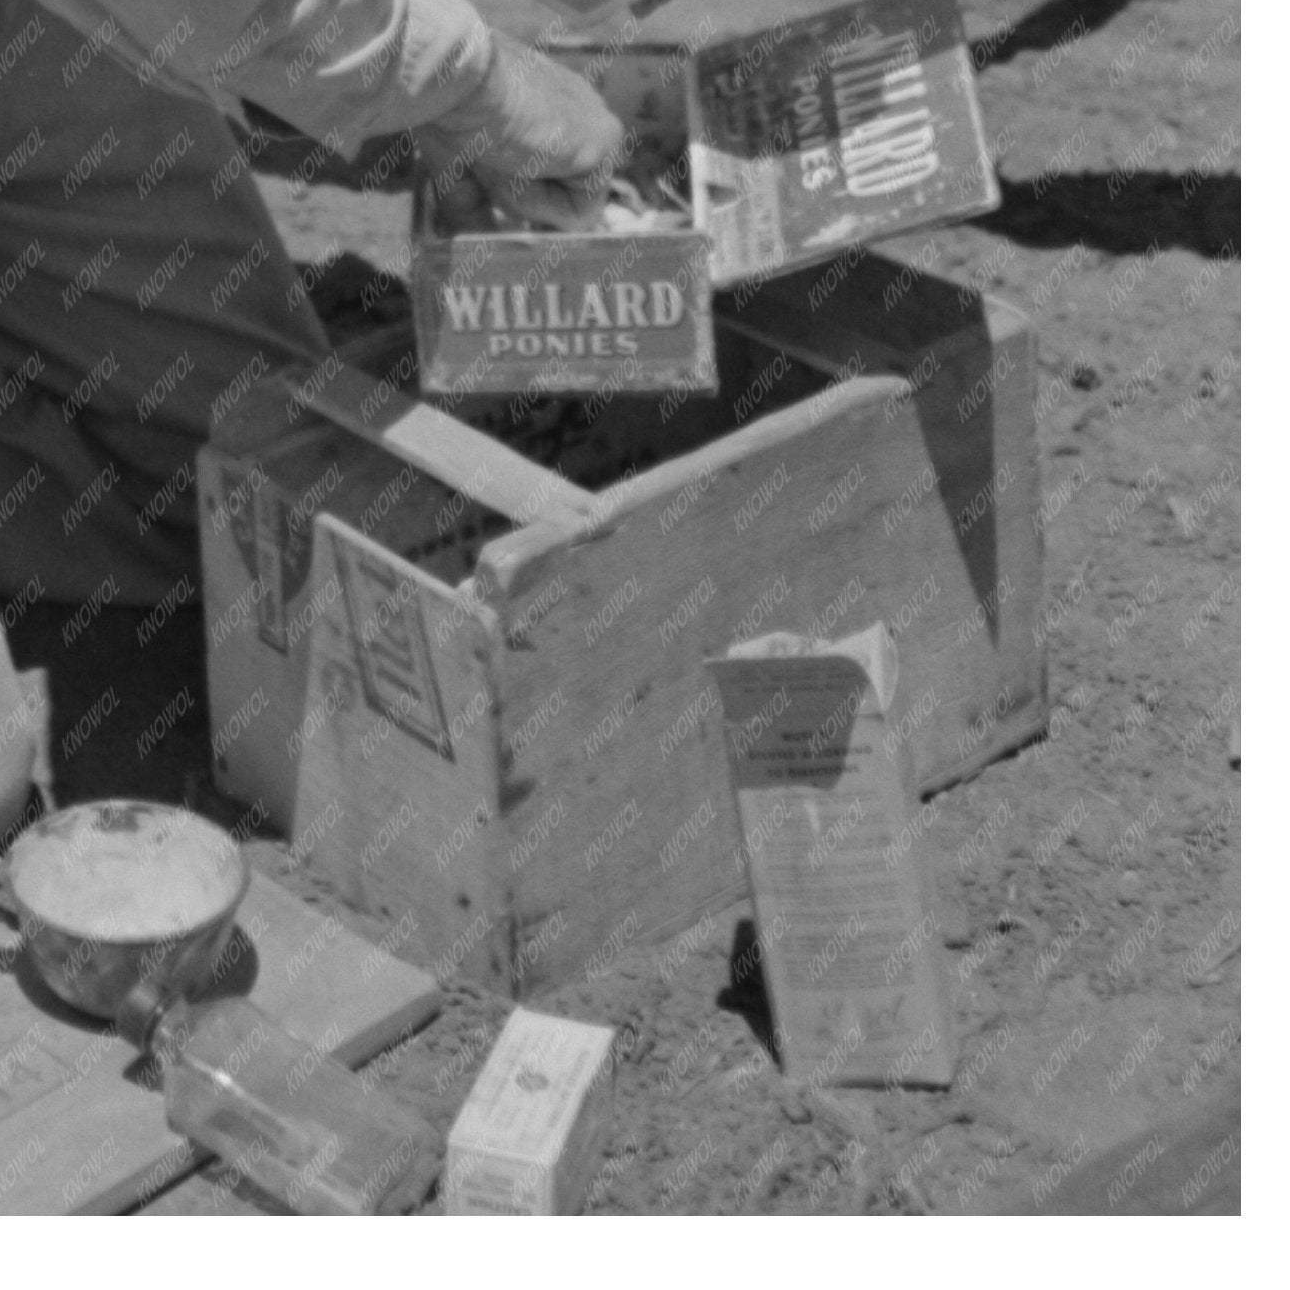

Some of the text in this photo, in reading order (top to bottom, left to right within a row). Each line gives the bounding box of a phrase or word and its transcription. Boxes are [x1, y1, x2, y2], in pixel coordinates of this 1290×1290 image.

[791, 74, 837, 191] PONIES
[830, 26, 940, 197] WILLARD
[443, 280, 685, 332] WILLARD
[488, 332, 640, 358] PONIES
